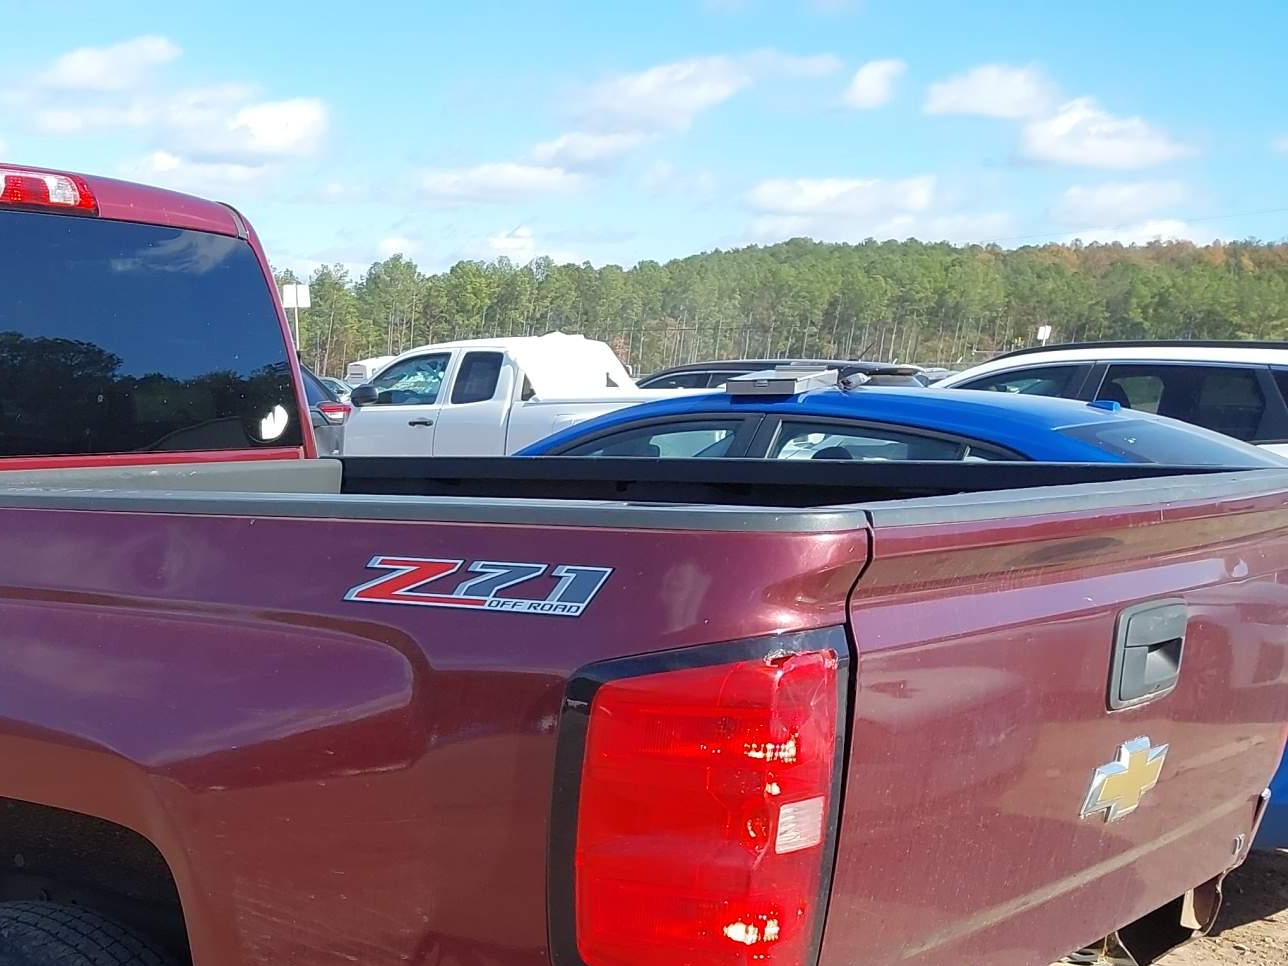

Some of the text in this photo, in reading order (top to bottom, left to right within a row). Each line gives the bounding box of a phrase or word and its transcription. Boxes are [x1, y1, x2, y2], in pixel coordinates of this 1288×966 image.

[343, 555, 615, 606] Z71
[487, 599, 581, 613] OFF ROAD
